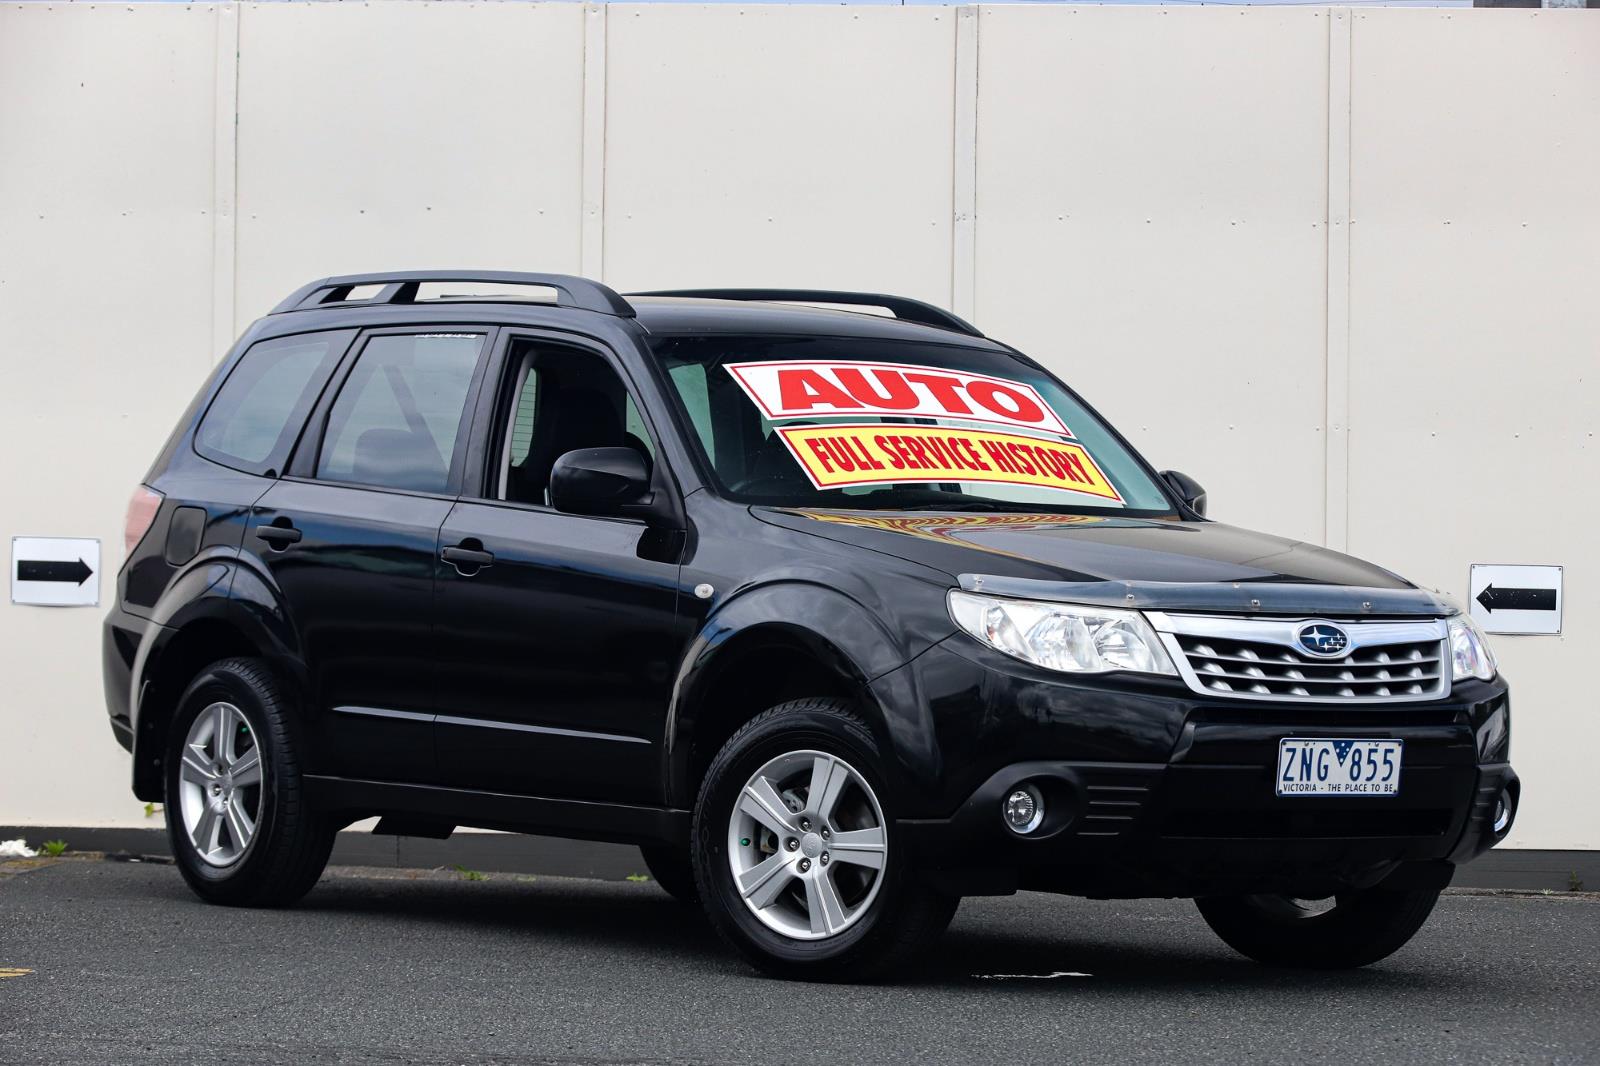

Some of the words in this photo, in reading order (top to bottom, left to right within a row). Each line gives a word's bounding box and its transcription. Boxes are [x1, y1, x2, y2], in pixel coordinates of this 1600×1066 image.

[777, 368, 1045, 422] AUTO
[804, 436, 886, 473] FULL
[873, 435, 993, 471] SERVICE
[978, 439, 1096, 486] HISTORY
[1282, 747, 1330, 782] ZNG
[1349, 747, 1395, 782] 855
[1283, 783, 1317, 792] VICTORIA
[1328, 783, 1341, 792] THE
[1345, 783, 1368, 792] PLACE
[1371, 783, 1380, 792] TO
[1384, 783, 1393, 792] BE
